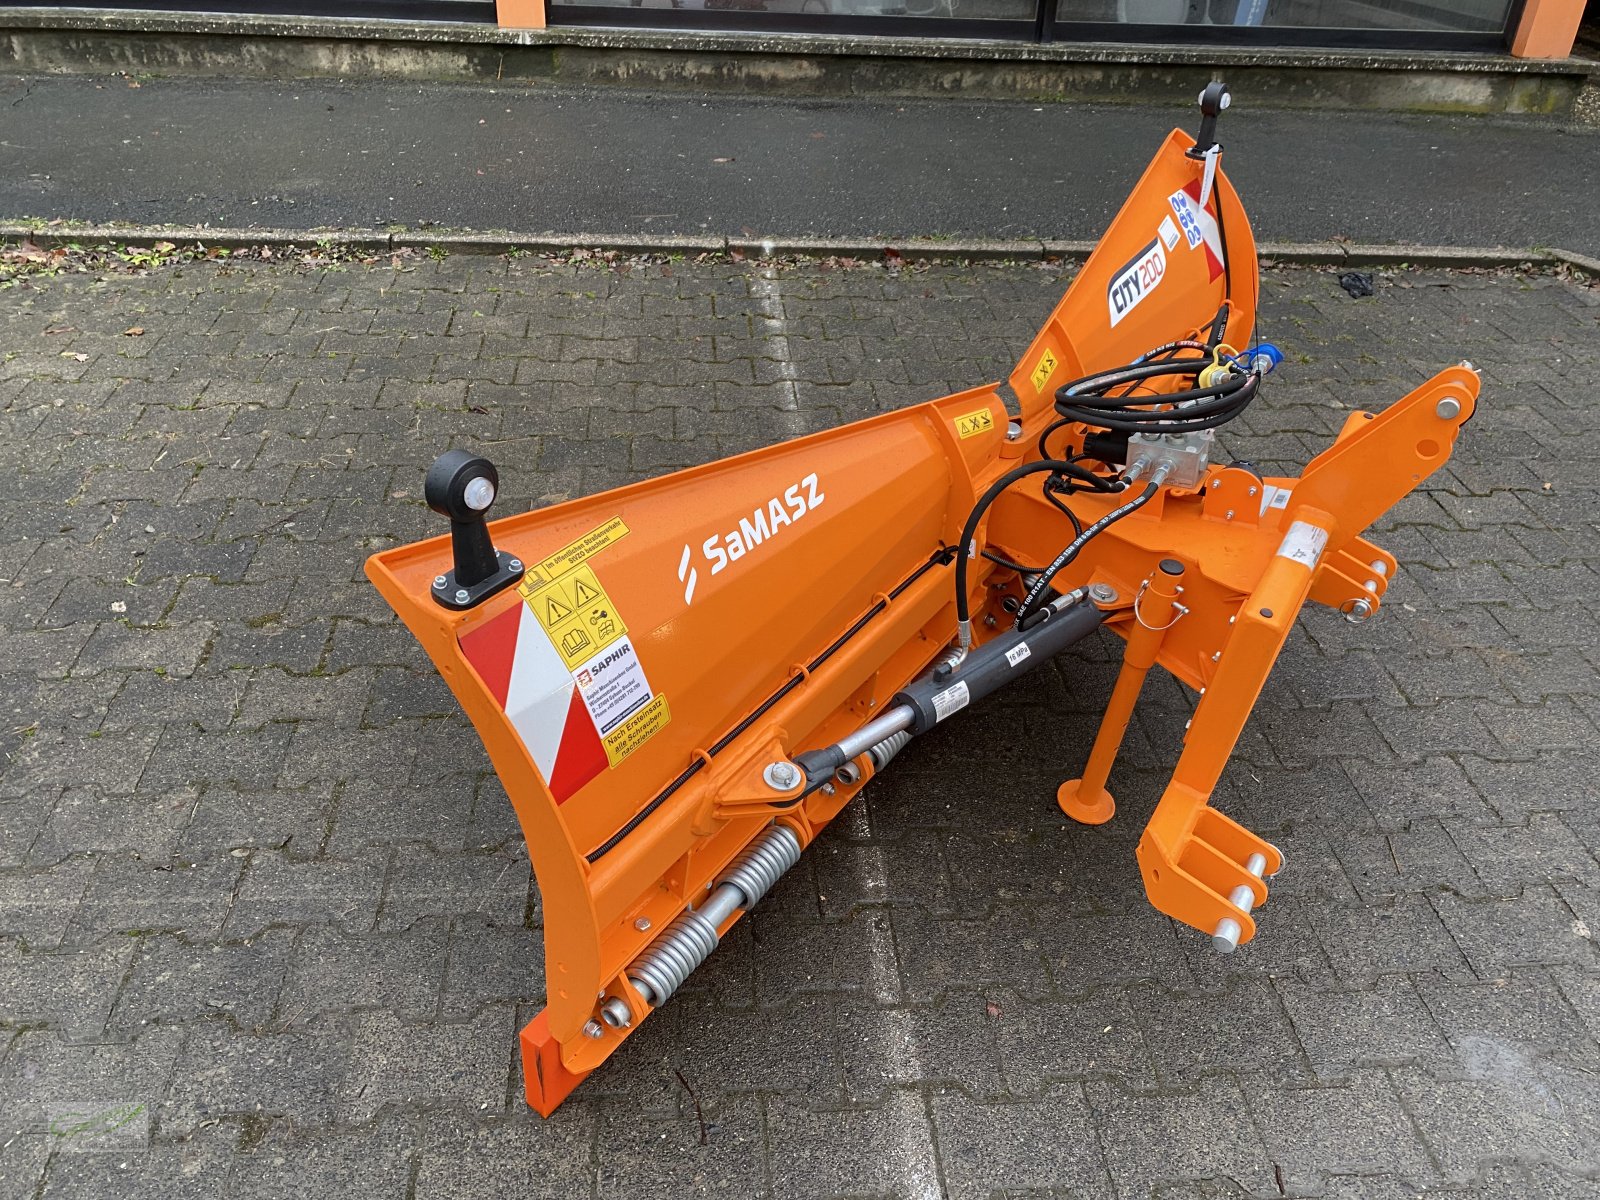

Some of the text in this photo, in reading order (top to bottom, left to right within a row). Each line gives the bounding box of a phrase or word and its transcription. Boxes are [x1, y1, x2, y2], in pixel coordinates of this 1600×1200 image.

[702, 472, 825, 576] SaMASZ
[553, 543, 585, 564] öffentlichen
[1017, 605, 1027, 617] SAE
[1024, 594, 1033, 606] 100
[1030, 577, 1045, 596] R1AT
[1045, 565, 1056, 576] EN
[1053, 555, 1065, 567] 853
[591, 643, 631, 677] SAPHIR
[1009, 646, 1028, 661] 16 MPa
[594, 708, 607, 720] Phone
[607, 700, 662, 746] Nach Ersteinsatz
[615, 711, 662, 753] alle Schrauben
[621, 721, 660, 757] nachziehen!
